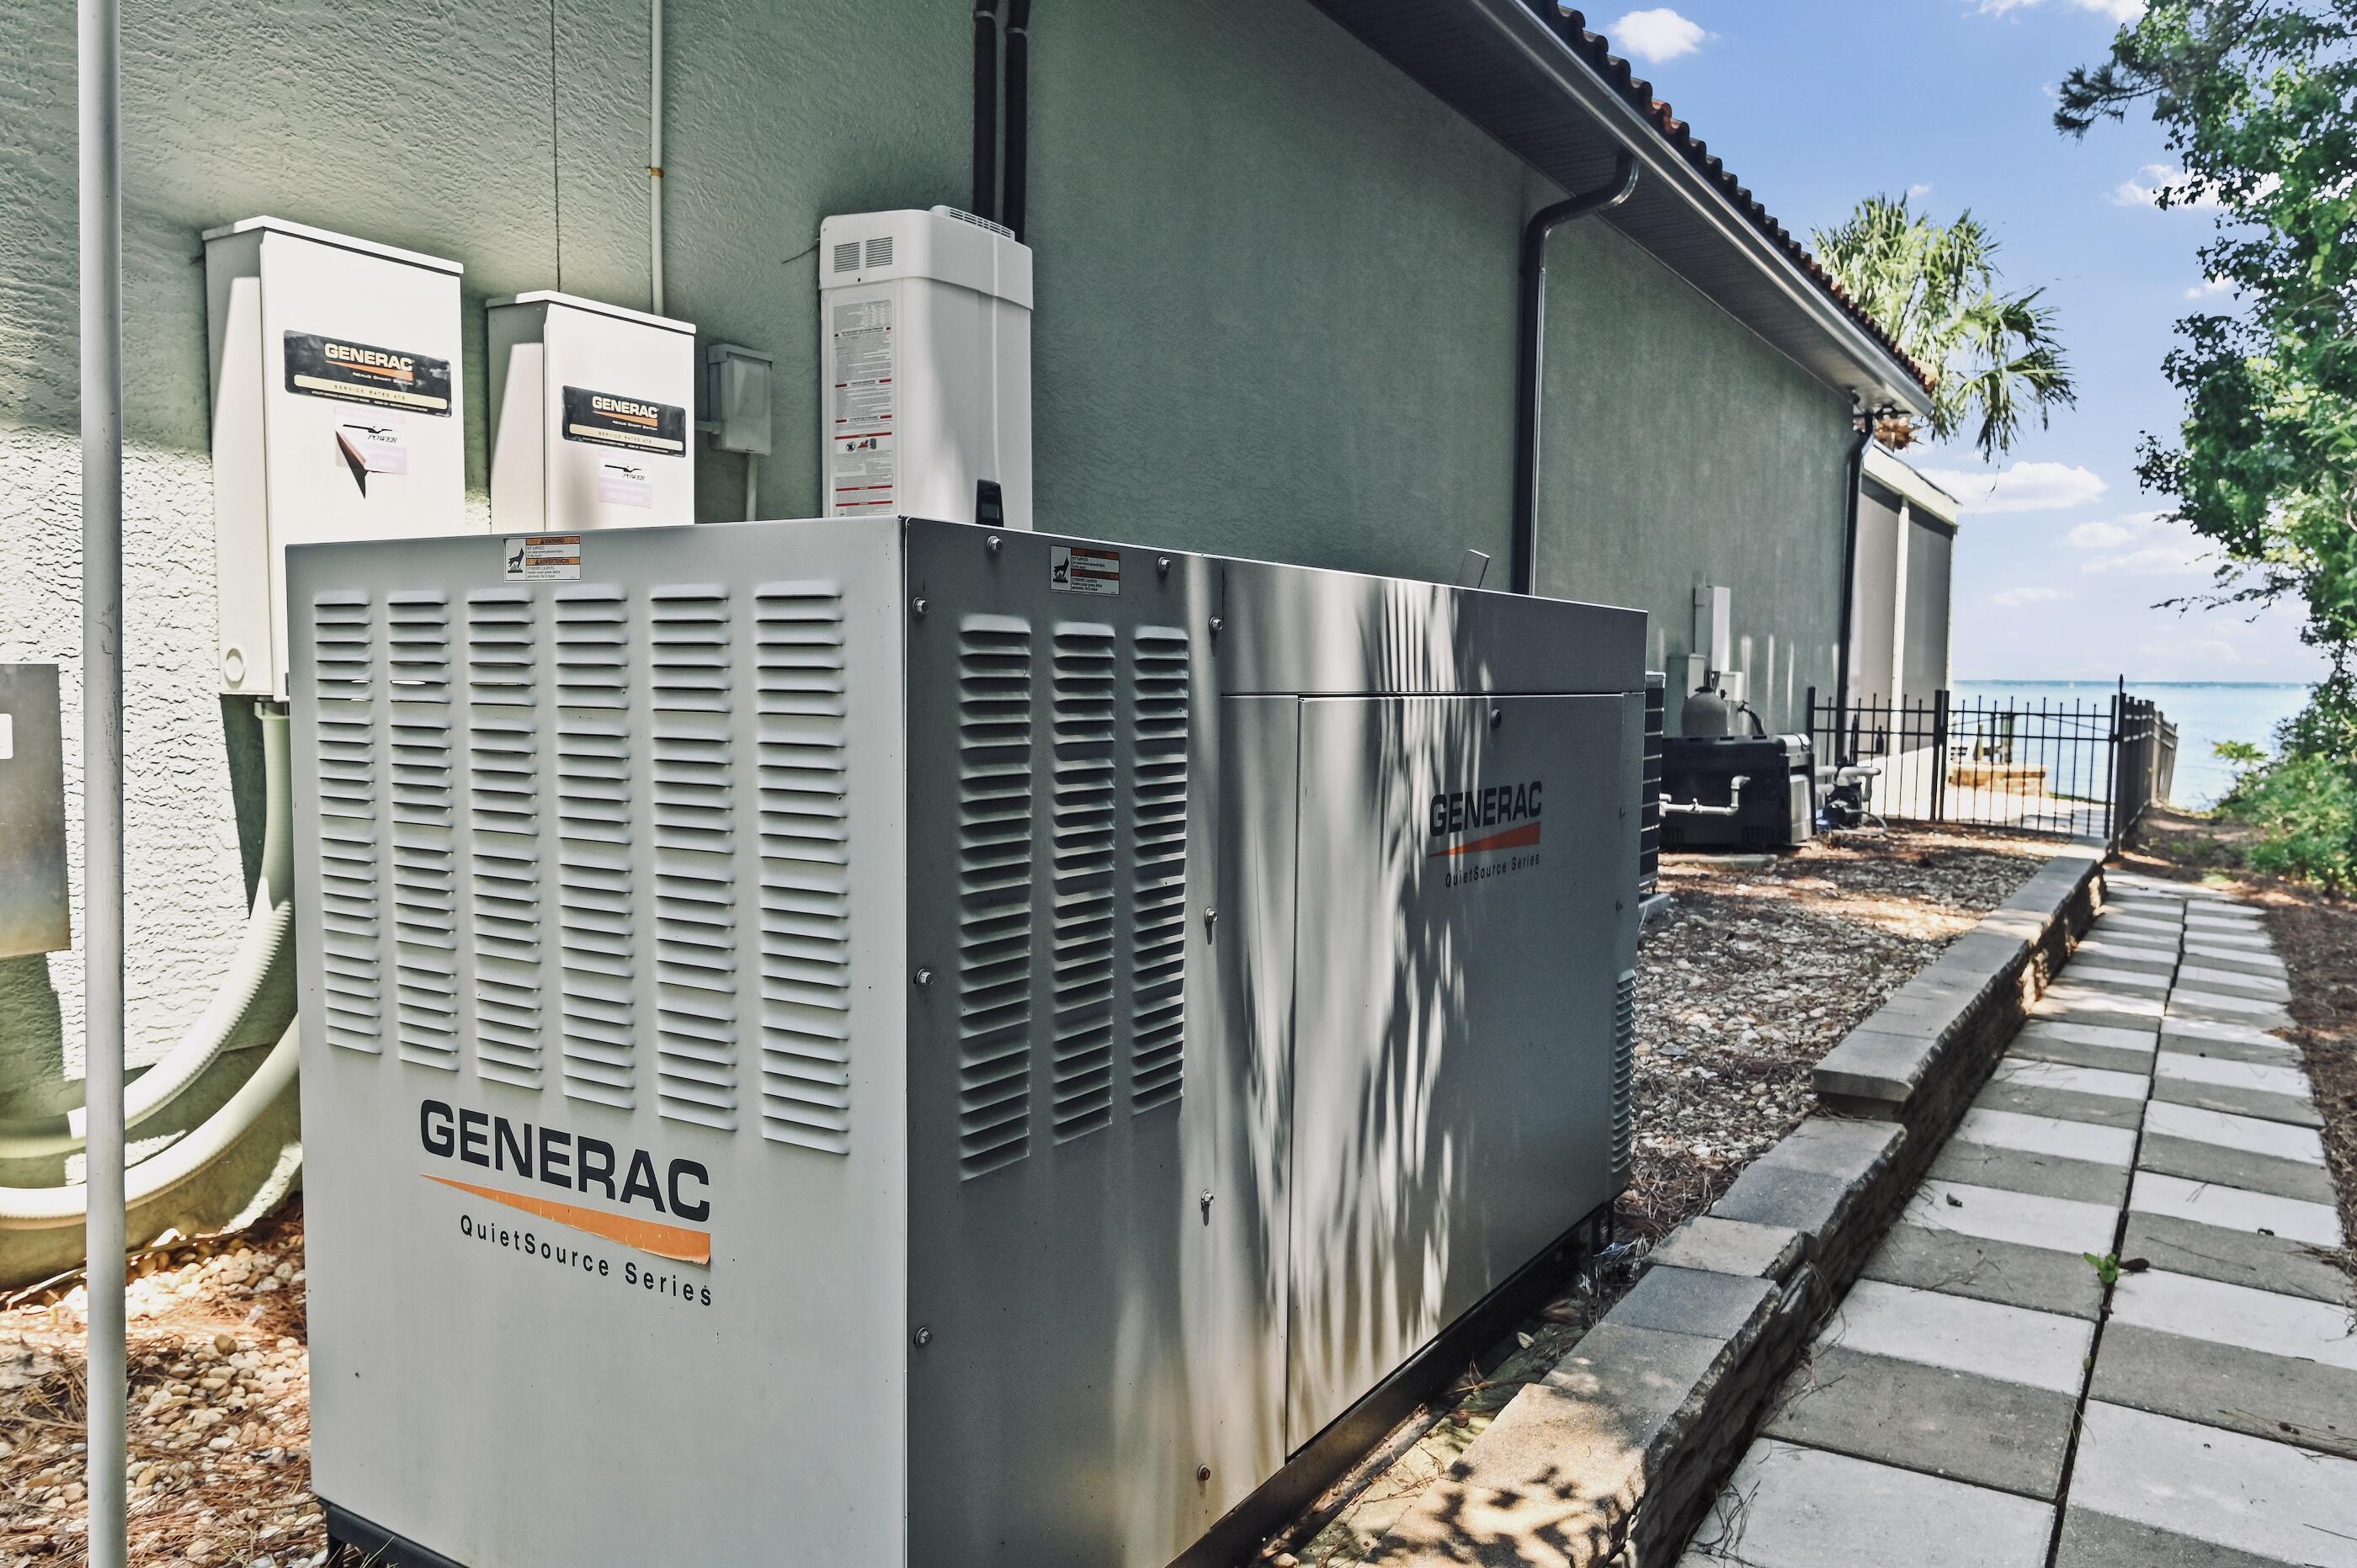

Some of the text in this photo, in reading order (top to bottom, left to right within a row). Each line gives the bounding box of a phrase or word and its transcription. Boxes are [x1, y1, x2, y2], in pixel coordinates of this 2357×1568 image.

[324, 343, 412, 370] GENERAC
[334, 385, 364, 394] SERVICE
[592, 396, 658, 418] GENERAC
[368, 434, 397, 443] POWER
[1429, 780, 1542, 837] GENERAC
[1445, 853, 1540, 887] QuietSource Series
[420, 1099, 710, 1222] GENERAC
[460, 1215, 711, 1306] QuietSource Series
